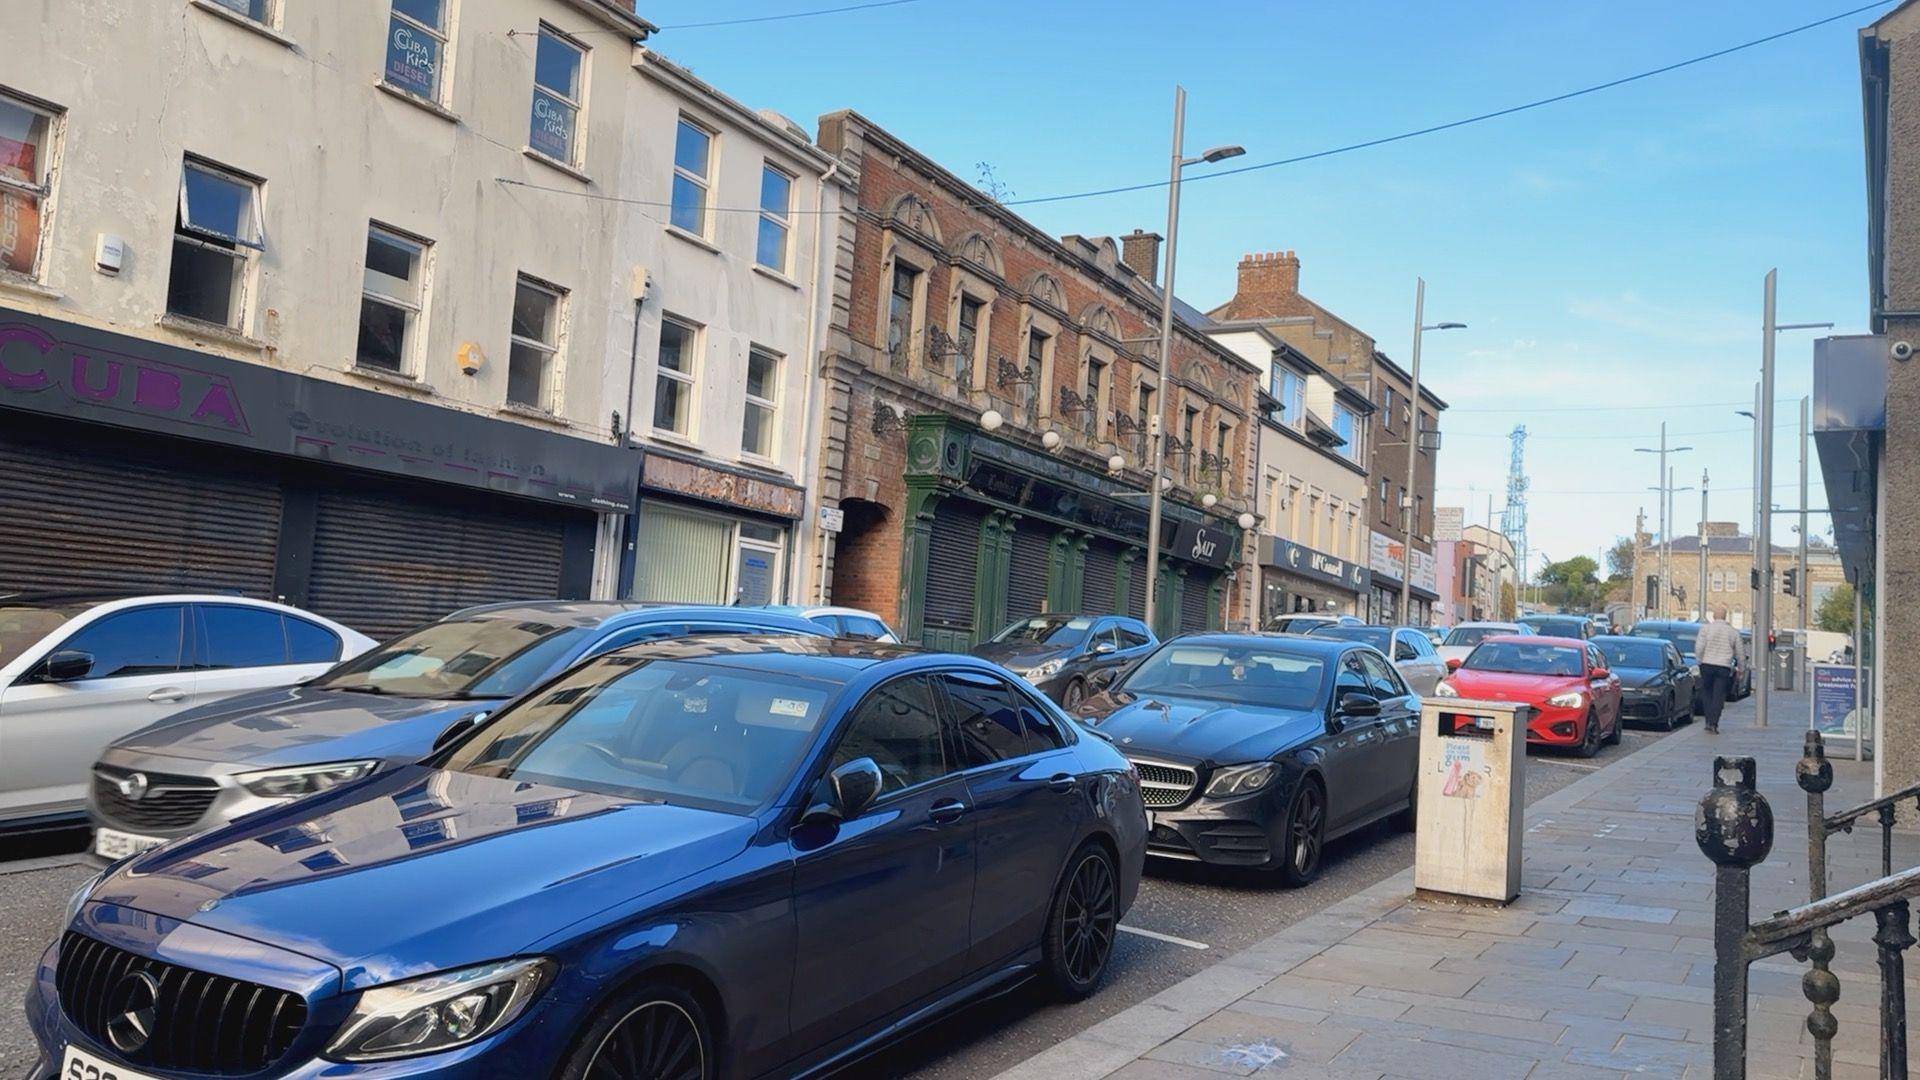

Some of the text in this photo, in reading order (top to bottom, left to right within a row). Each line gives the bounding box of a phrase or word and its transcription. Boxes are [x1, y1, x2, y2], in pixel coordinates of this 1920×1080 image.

[394, 28, 429, 58] CUBA
[394, 61, 428, 85] DIESEL
[534, 98, 564, 124] CUBA
[0, 326, 243, 427] CUBA
